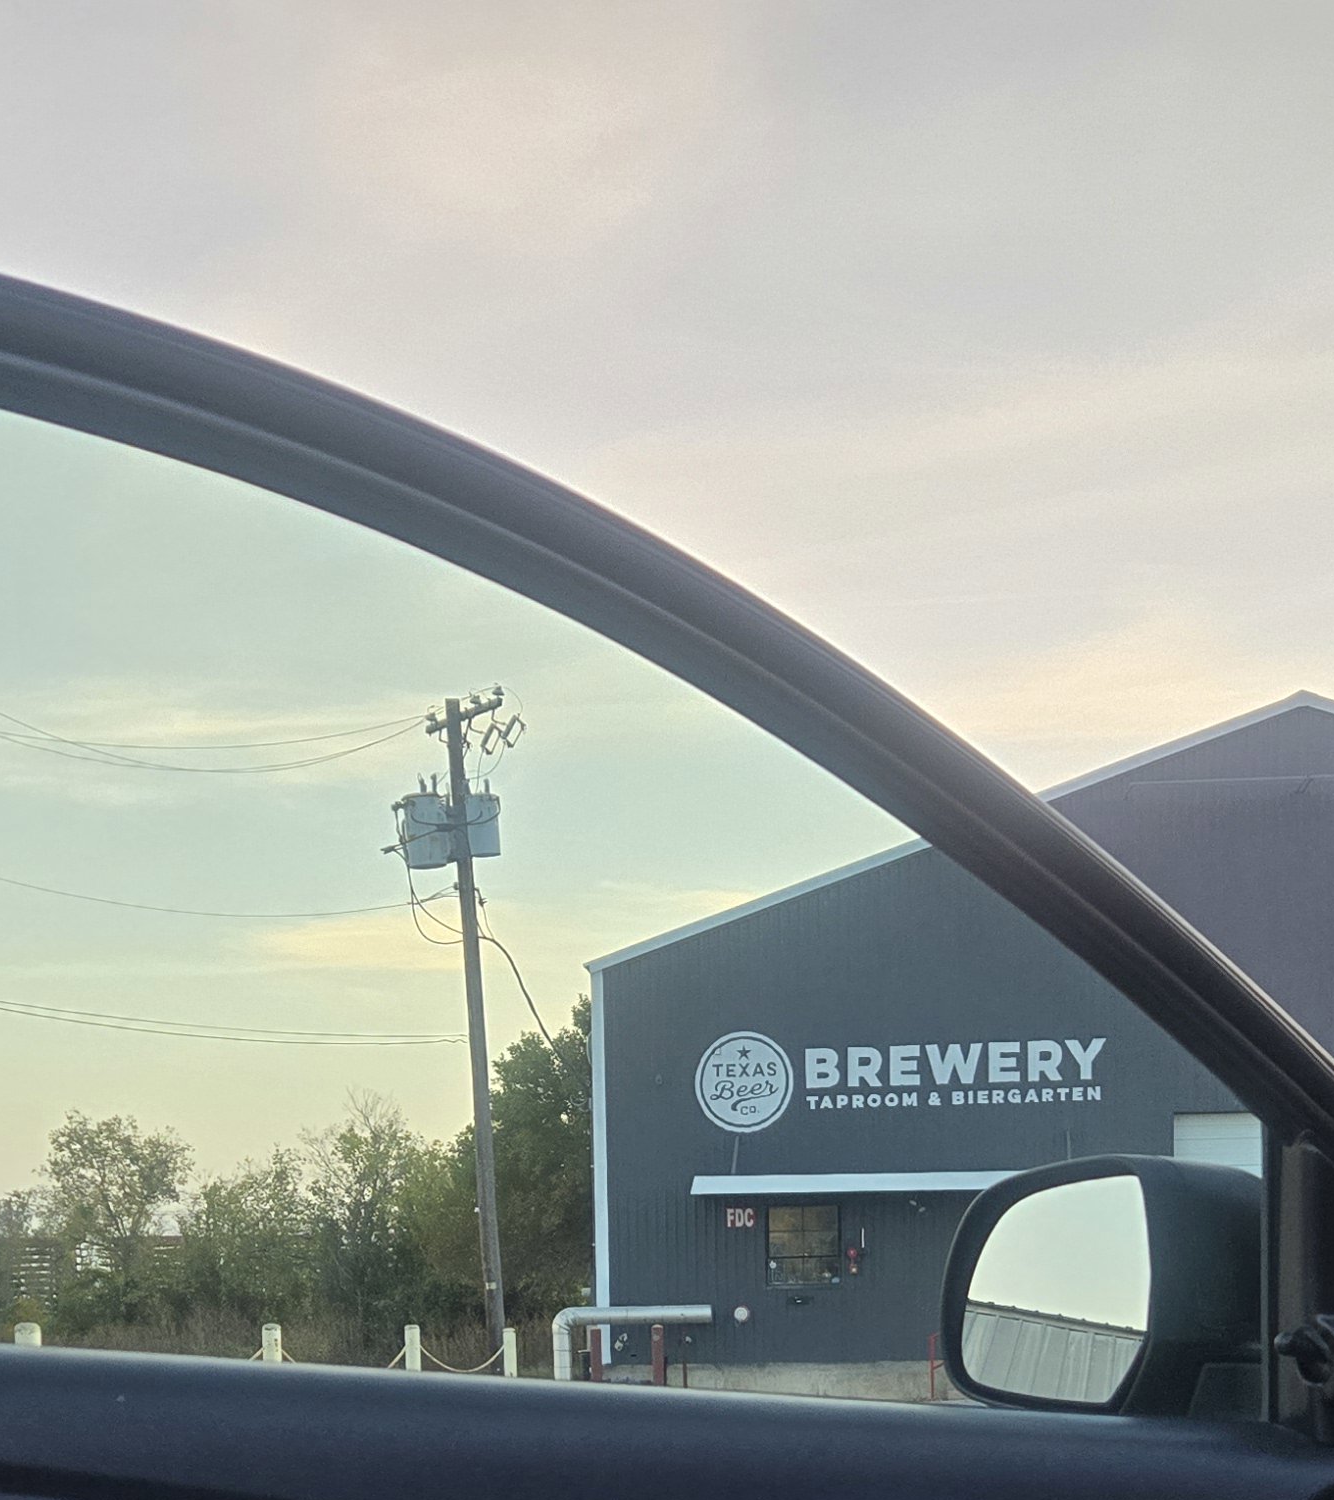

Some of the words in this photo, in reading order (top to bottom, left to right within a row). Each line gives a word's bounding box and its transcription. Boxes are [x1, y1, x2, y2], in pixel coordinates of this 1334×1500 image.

[712, 1062, 777, 1077] TEXAS
[805, 1038, 1106, 1089] BREWERY
[710, 1080, 779, 1111] Beer
[806, 1092, 918, 1110] TAPROOM
[928, 1092, 941, 1106] &
[951, 1086, 1102, 1105] BIERGARTEN
[740, 1105, 760, 1115] CO.
[726, 1208, 754, 1228] FDC
